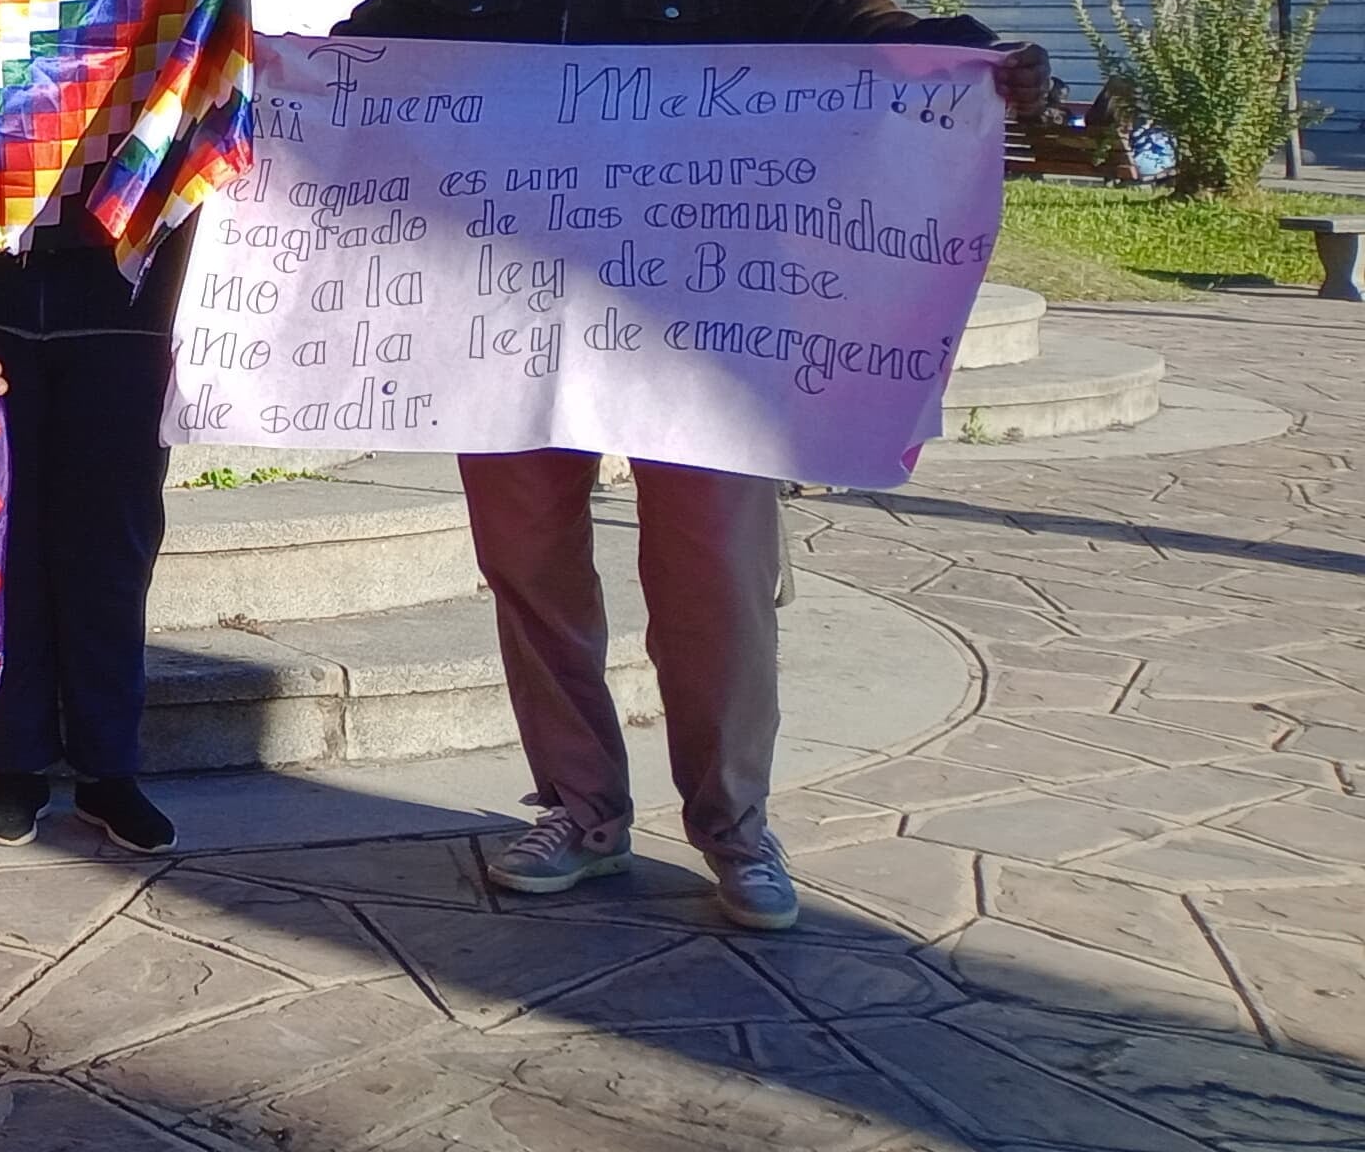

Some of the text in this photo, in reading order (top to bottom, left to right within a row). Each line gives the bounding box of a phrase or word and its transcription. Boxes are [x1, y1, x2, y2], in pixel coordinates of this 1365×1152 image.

[226, 157, 817, 229] el agua es un recurso
[218, 208, 427, 274] sagrado
[466, 199, 518, 239] de
[548, 193, 623, 231] las
[311, 279, 344, 312] a
[366, 255, 423, 308] la
[478, 244, 565, 313] ley
[598, 239, 669, 288] de
[292, 340, 326, 367] a
[353, 320, 413, 367] la
[468, 314, 562, 378] ley
[584, 307, 643, 351] de
[664, 320, 953, 395] emergenci
[178, 384, 234, 430] de
